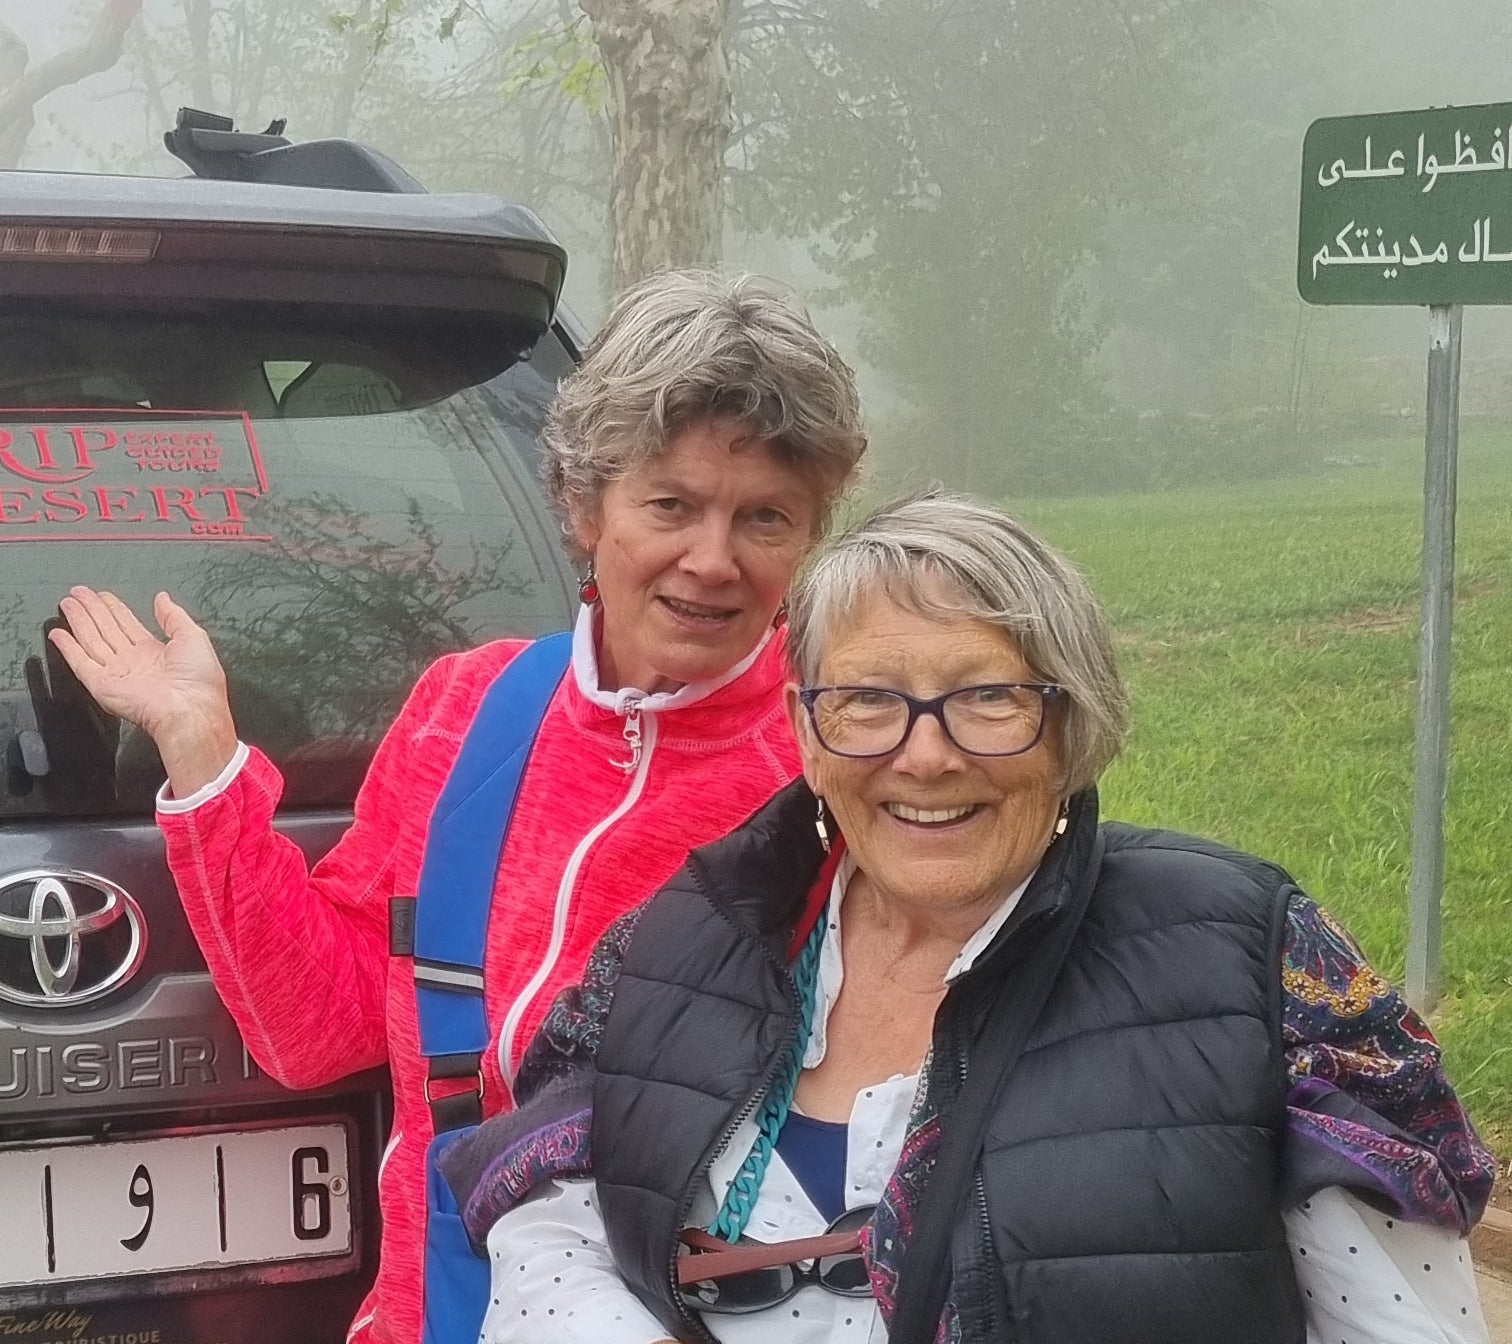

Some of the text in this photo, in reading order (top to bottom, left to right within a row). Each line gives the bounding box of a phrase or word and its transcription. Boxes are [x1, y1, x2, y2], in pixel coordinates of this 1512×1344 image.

[1317, 124, 1512, 194] افظوا على
[1311, 215, 1512, 281] ال مدينتكم
[124, 431, 216, 446] EXPERT
[125, 444, 223, 459] GUIDED
[135, 457, 221, 473] TOURS
[290, 1144, 331, 1242] 6
